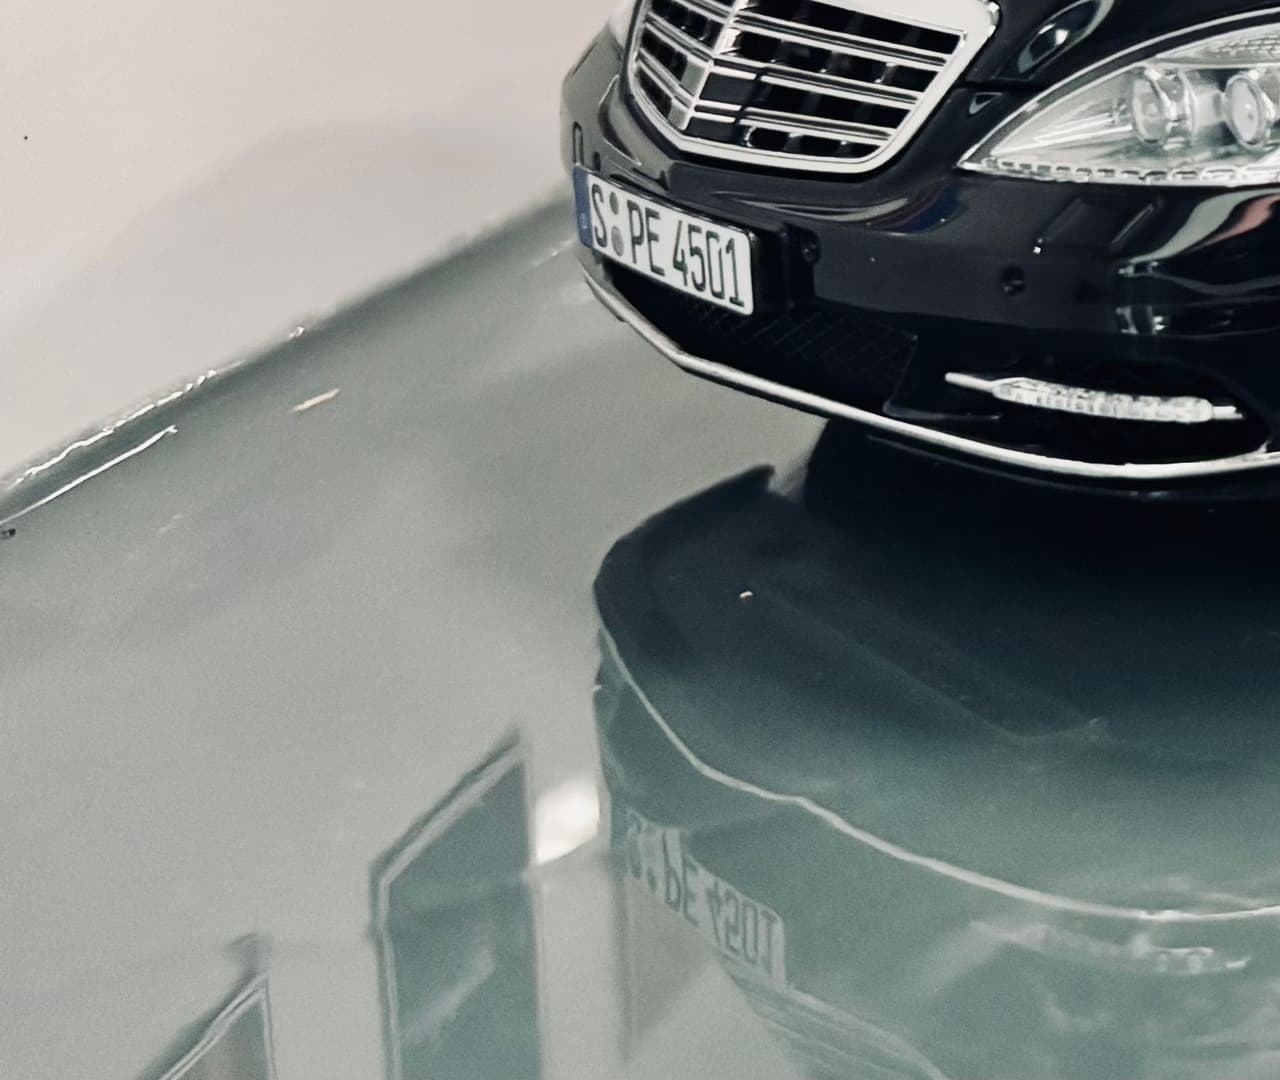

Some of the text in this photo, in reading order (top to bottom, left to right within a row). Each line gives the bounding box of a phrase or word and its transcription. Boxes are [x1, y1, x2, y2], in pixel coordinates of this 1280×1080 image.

[591, 183, 746, 308] S PE 4501
